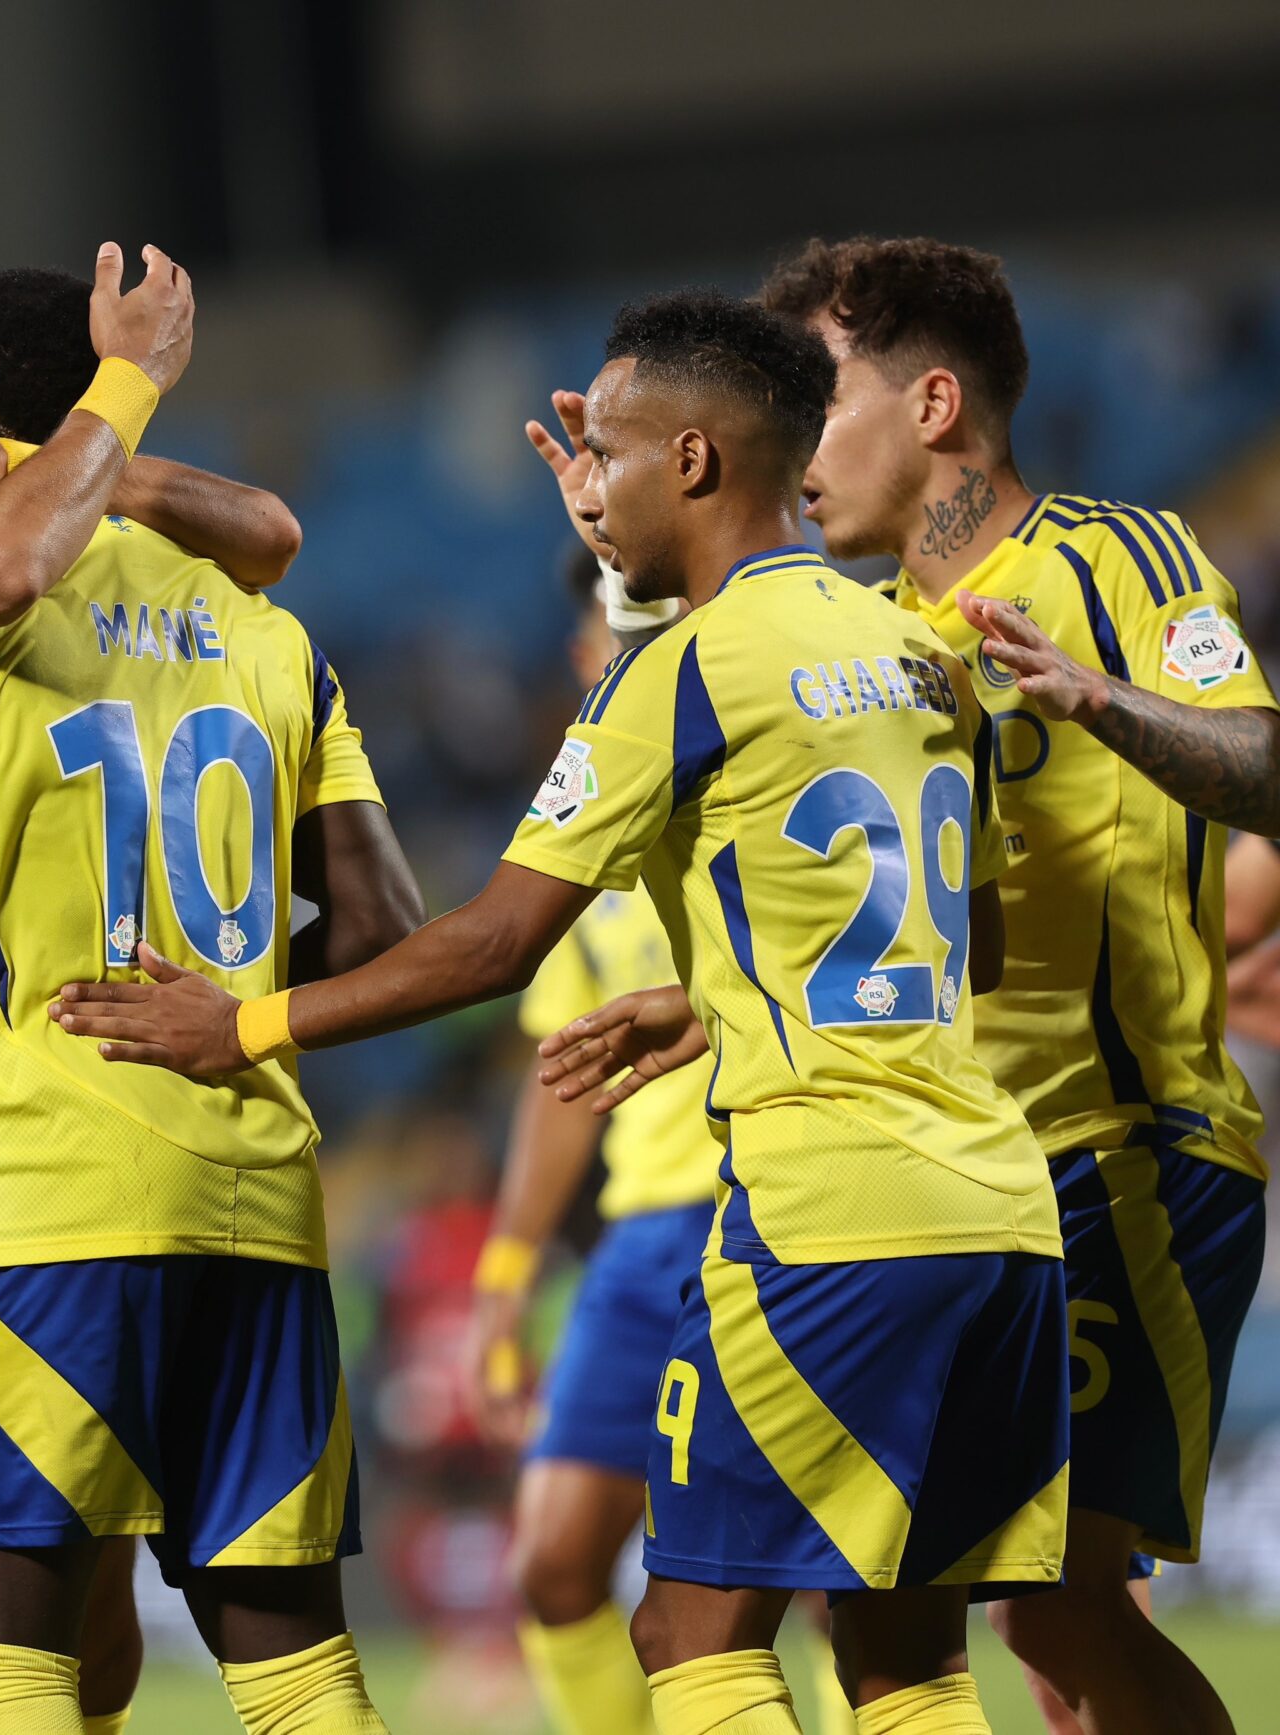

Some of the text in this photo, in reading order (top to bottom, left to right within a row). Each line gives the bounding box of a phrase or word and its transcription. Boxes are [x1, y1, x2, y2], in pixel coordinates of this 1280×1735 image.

[89, 596, 225, 662] MANÉ
[1189, 638, 1223, 658] RSL
[789, 656, 959, 720] GHAREEB
[46, 700, 275, 971] 10
[782, 763, 972, 1028] 29
[869, 991, 885, 999] RSL
[656, 1357, 700, 1486] 9
